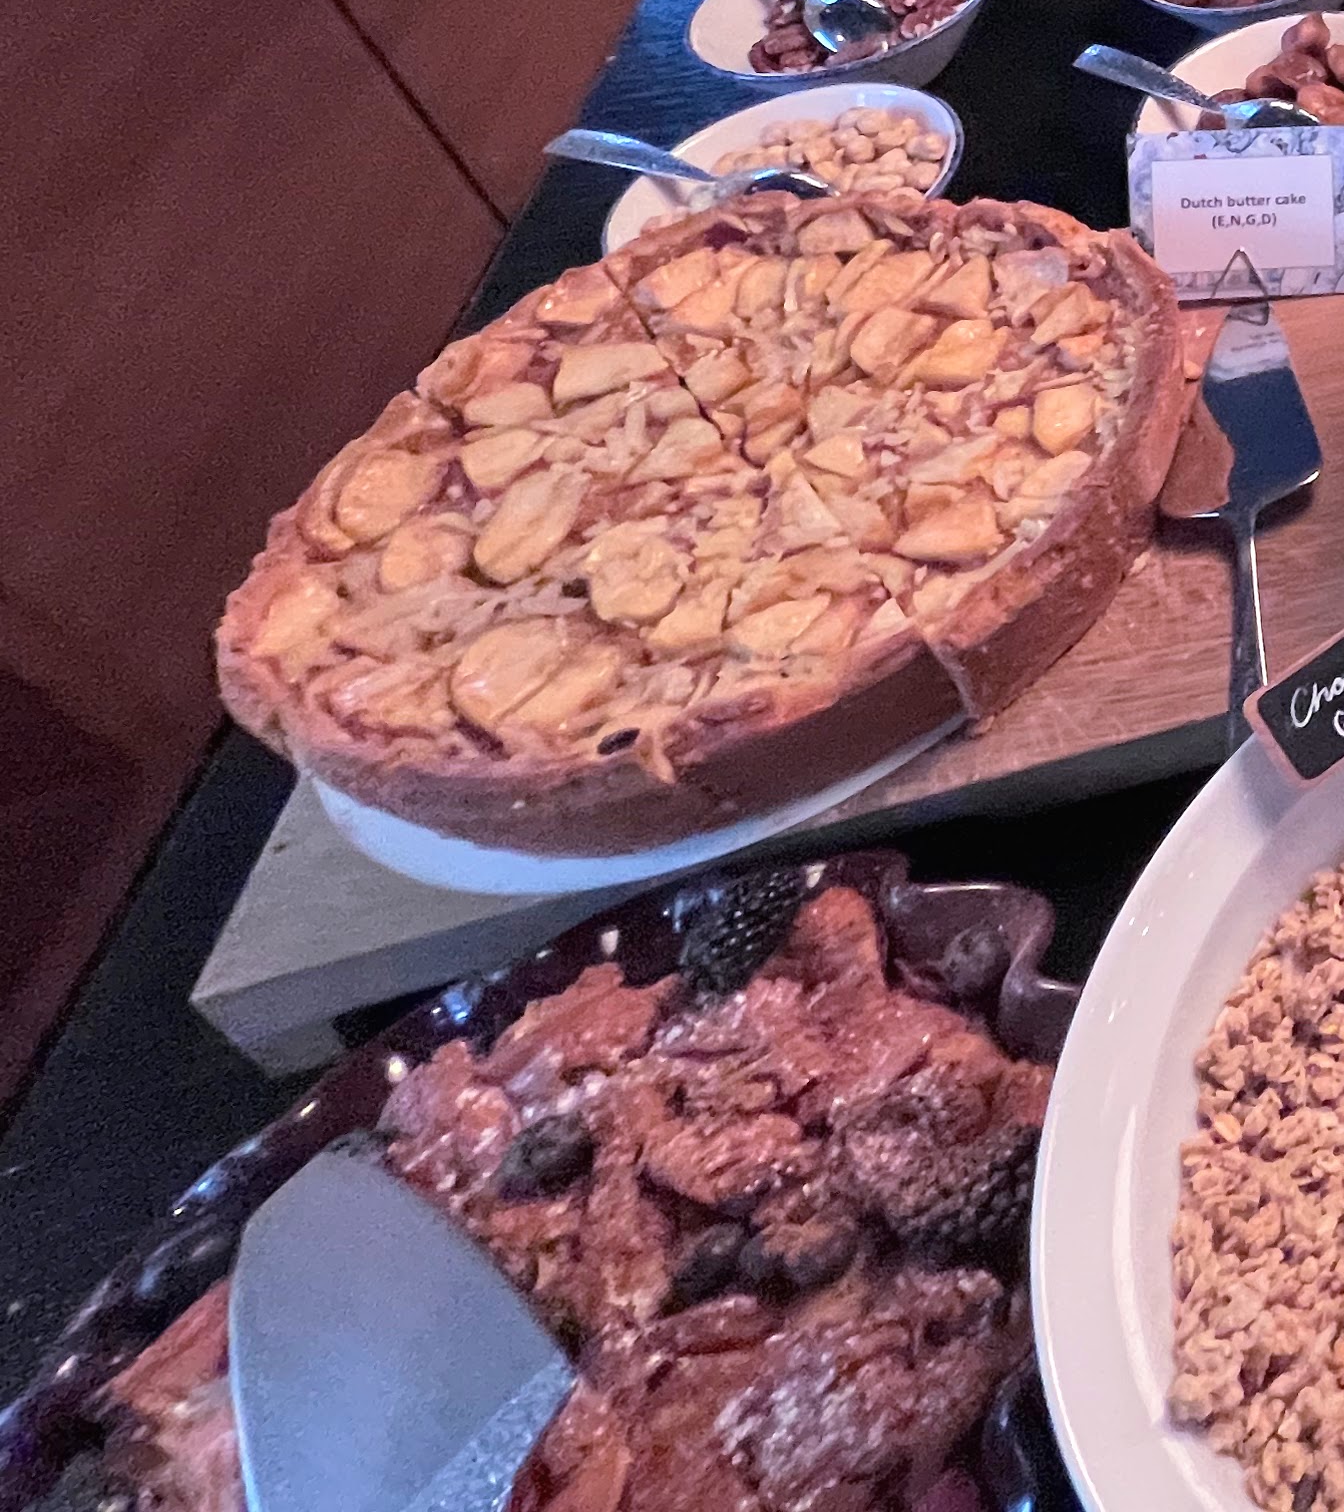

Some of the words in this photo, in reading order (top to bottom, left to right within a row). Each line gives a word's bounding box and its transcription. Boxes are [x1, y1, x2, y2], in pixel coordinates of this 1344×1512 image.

[1180, 196, 1223, 209] Dutch
[1227, 195, 1271, 207] butter
[1275, 193, 1306, 206] cake
[1211, 212, 1278, 230] (E,N,G,D)
